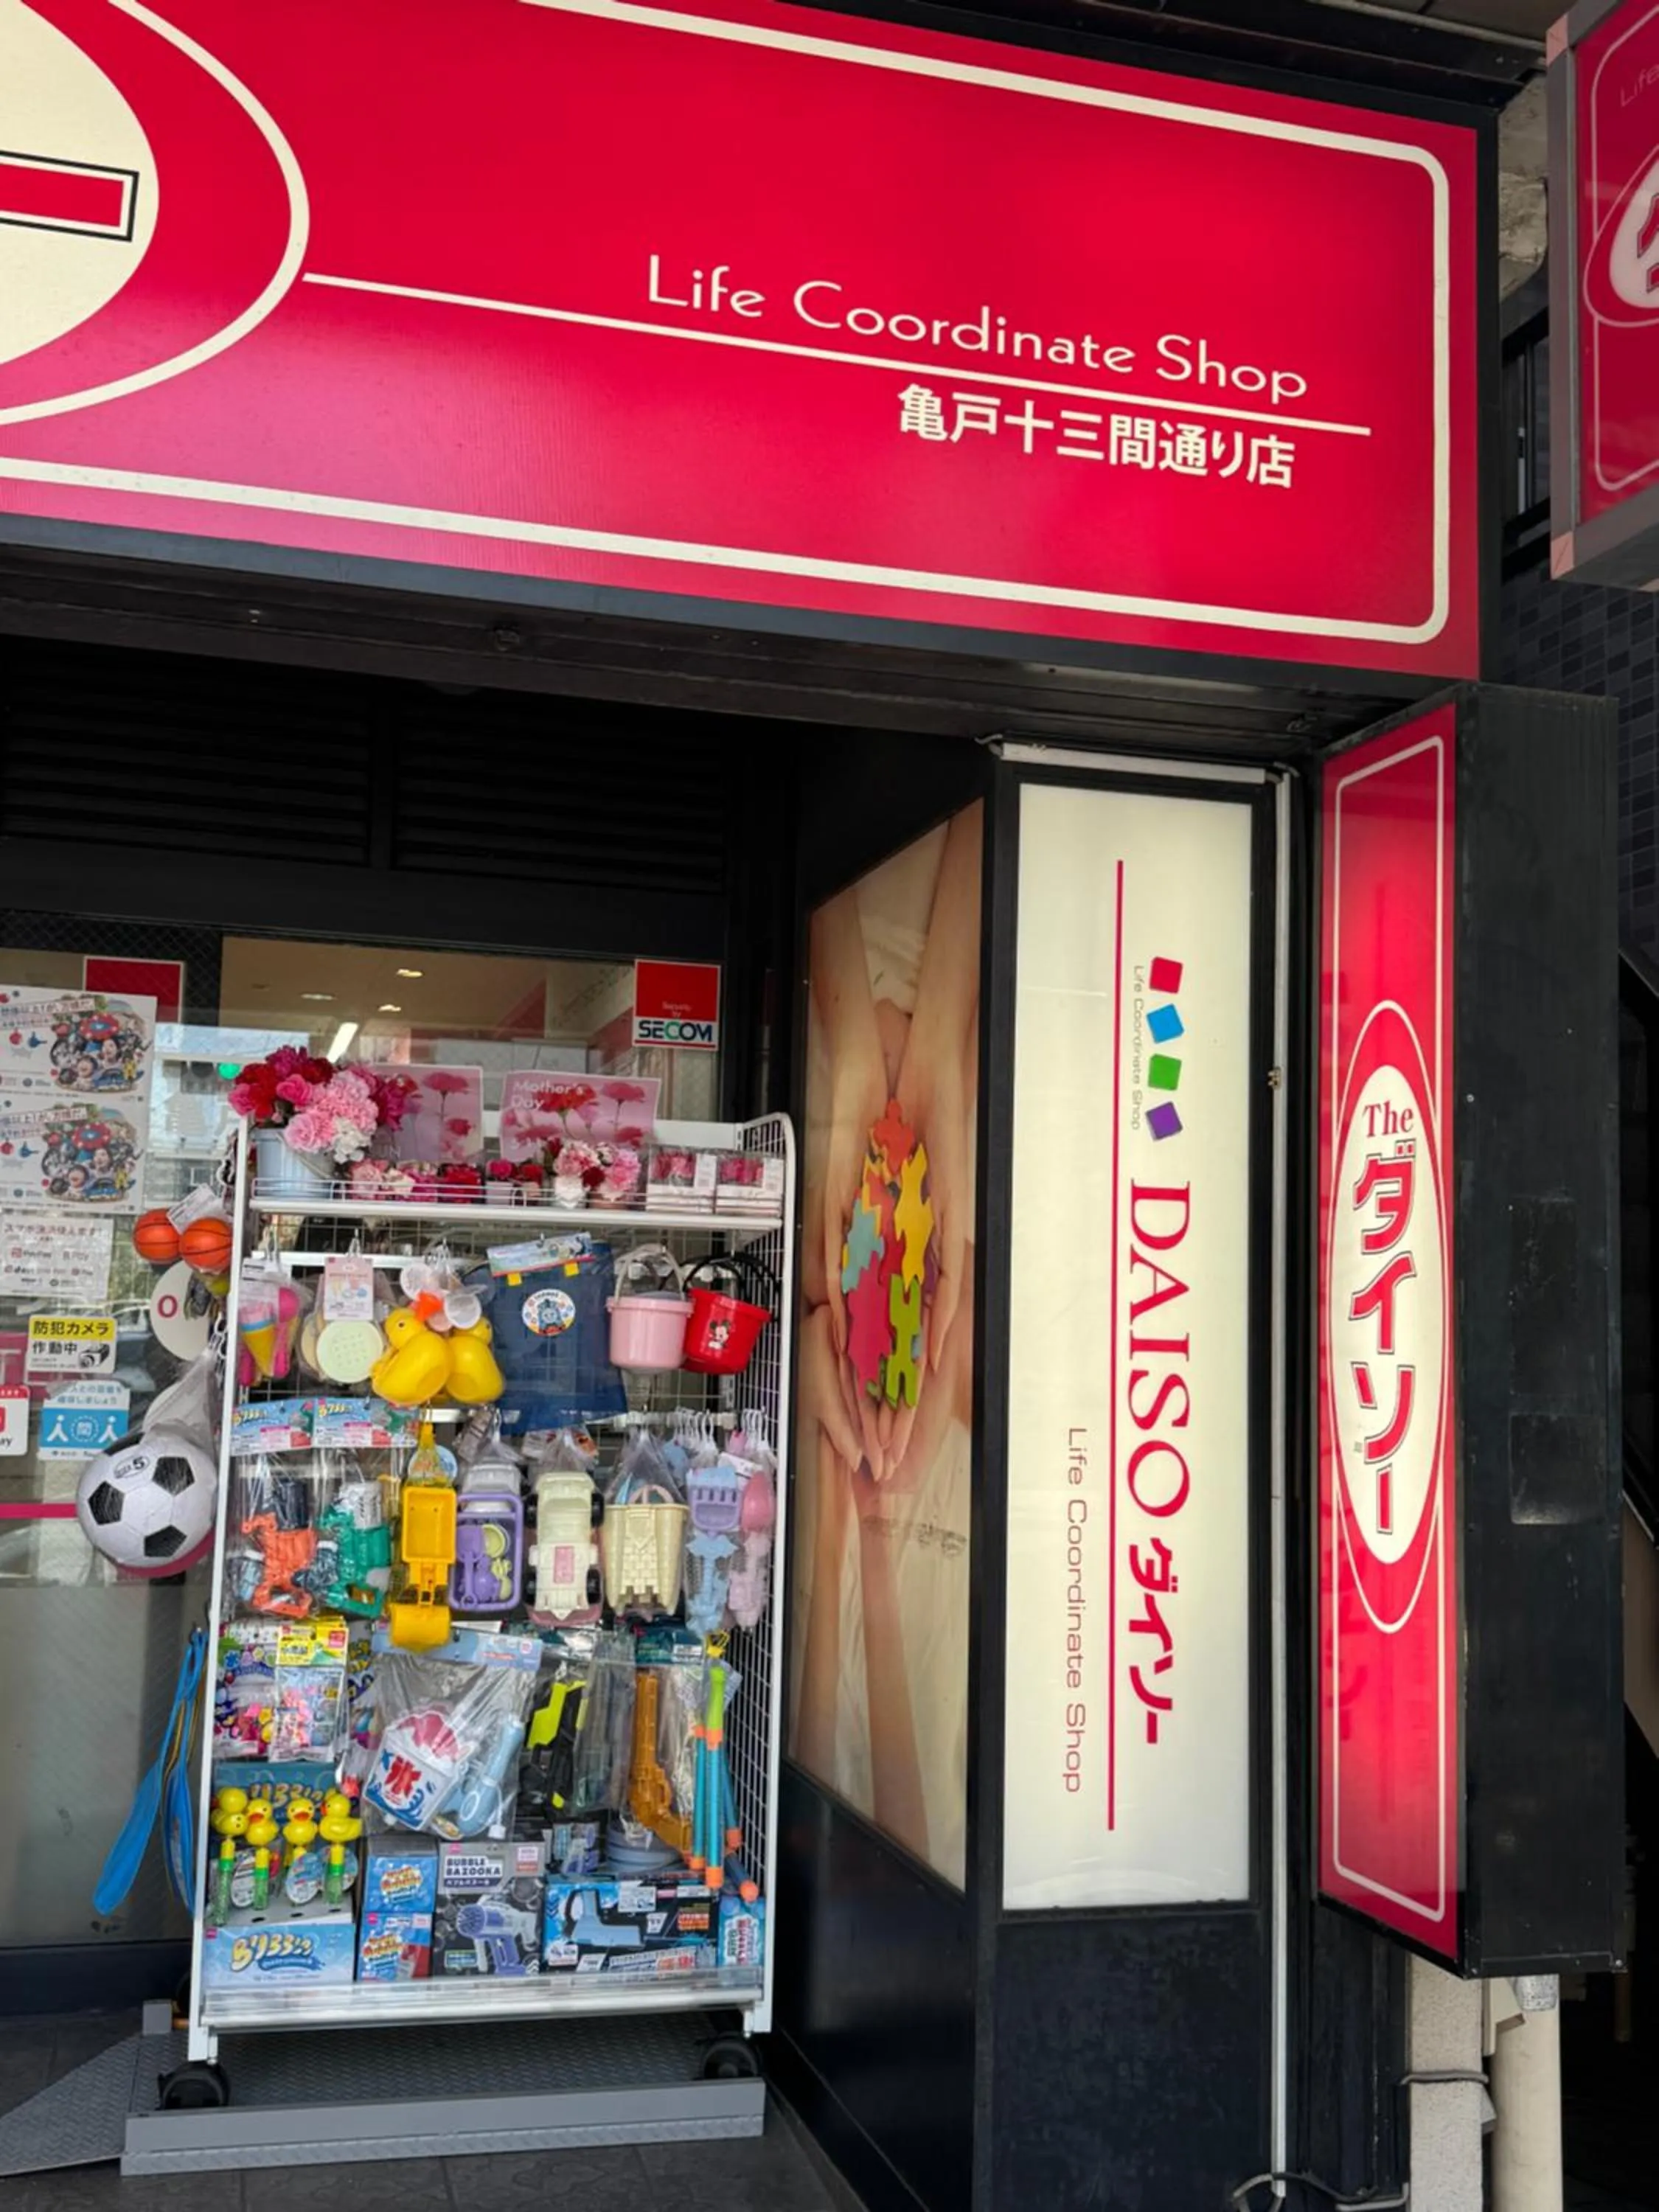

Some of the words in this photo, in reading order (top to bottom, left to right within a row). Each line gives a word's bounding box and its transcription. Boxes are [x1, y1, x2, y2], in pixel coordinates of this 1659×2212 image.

[647, 254, 766, 319] Life
[793, 279, 1137, 374] Coordinate
[1155, 333, 1308, 405] Shop
[897, 383, 1295, 489] 亀戸十三間通り店
[1133, 964, 1144, 994] Life
[638, 1019, 713, 1043] SECOM
[1132, 997, 1143, 1085] Coordinate
[509, 1094, 545, 1113] Day
[512, 1078, 585, 1097] Mother's
[1130, 1090, 1142, 1131] Shop
[1362, 1099, 1416, 1140] The
[32, 1321, 110, 1337] 防犯カメラ
[32, 1341, 77, 1355] 作動中
[1127, 1178, 1192, 1518] DAISO
[1349, 1139, 1419, 1536] ダイソー
[133, 1455, 145, 1470] 5
[1066, 1427, 1088, 1486] Life
[1065, 1499, 1088, 1690] Coordinate
[1128, 1537, 1180, 1745] ダイソー
[1063, 1703, 1087, 1794] Shop
[446, 1867, 501, 1877] BAZOOKA
[447, 1857, 487, 1867] BUBBLE
